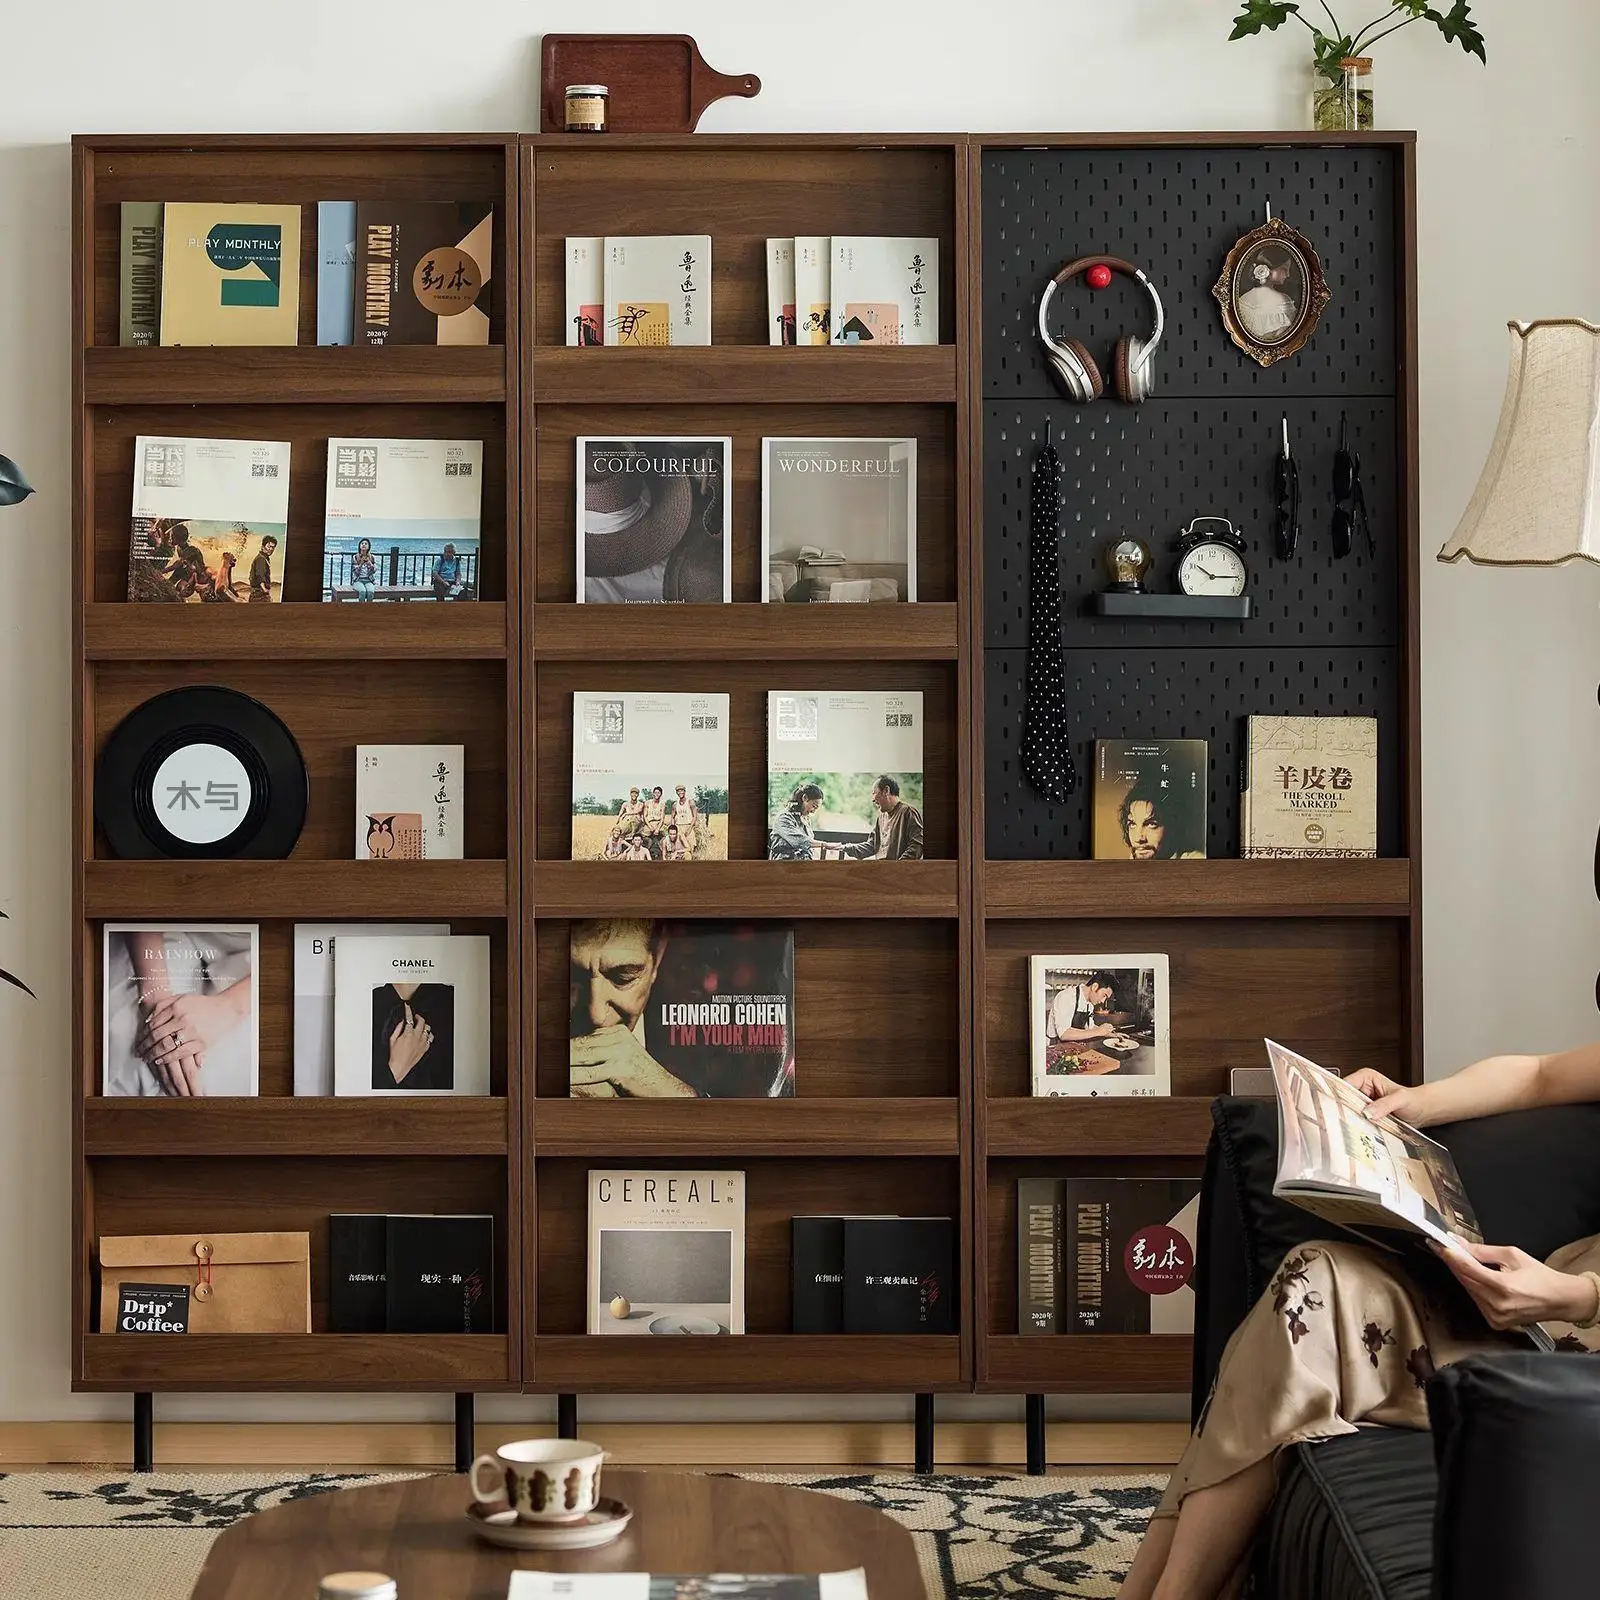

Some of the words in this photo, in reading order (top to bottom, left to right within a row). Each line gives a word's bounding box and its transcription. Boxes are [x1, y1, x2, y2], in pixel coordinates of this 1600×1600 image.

[132, 226, 157, 258] PLAY
[188, 239, 219, 248] PLAY
[225, 240, 281, 249] MONTHLY
[367, 224, 392, 258] PLAY
[131, 265, 156, 326] MONTHLY
[365, 263, 392, 327] MONTHLY
[366, 330, 389, 338] 2020年
[593, 457, 718, 473] COLOURFUL
[778, 459, 901, 473] WONDERFUL
[1273, 765, 1353, 790] 羊皮卷
[166, 780, 239, 811] 木与
[1282, 792, 1303, 800] THE
[1304, 792, 1346, 801] SCROLL
[1290, 800, 1338, 809] MARKED
[144, 949, 217, 960] RAINBOW
[661, 1004, 730, 1026] LEONARD
[735, 1004, 787, 1026] COHEN
[670, 1025, 697, 1046] I'M
[701, 1025, 743, 1046] YOUR
[747, 1025, 785, 1046] MAN
[599, 1178, 720, 1203] CEREAL
[1029, 1205, 1054, 1237] PLAY
[1077, 1204, 1101, 1237] PLAY
[421, 1274, 462, 1284] 现实一种
[865, 1276, 919, 1285] 许三观卖血记
[1029, 1243, 1054, 1308] MONTHLY
[1077, 1242, 1102, 1307] MONTHLY
[122, 1316, 185, 1333] Coffee
[1031, 1312, 1053, 1320] 2020年
[1079, 1311, 1100, 1319] 2020年
